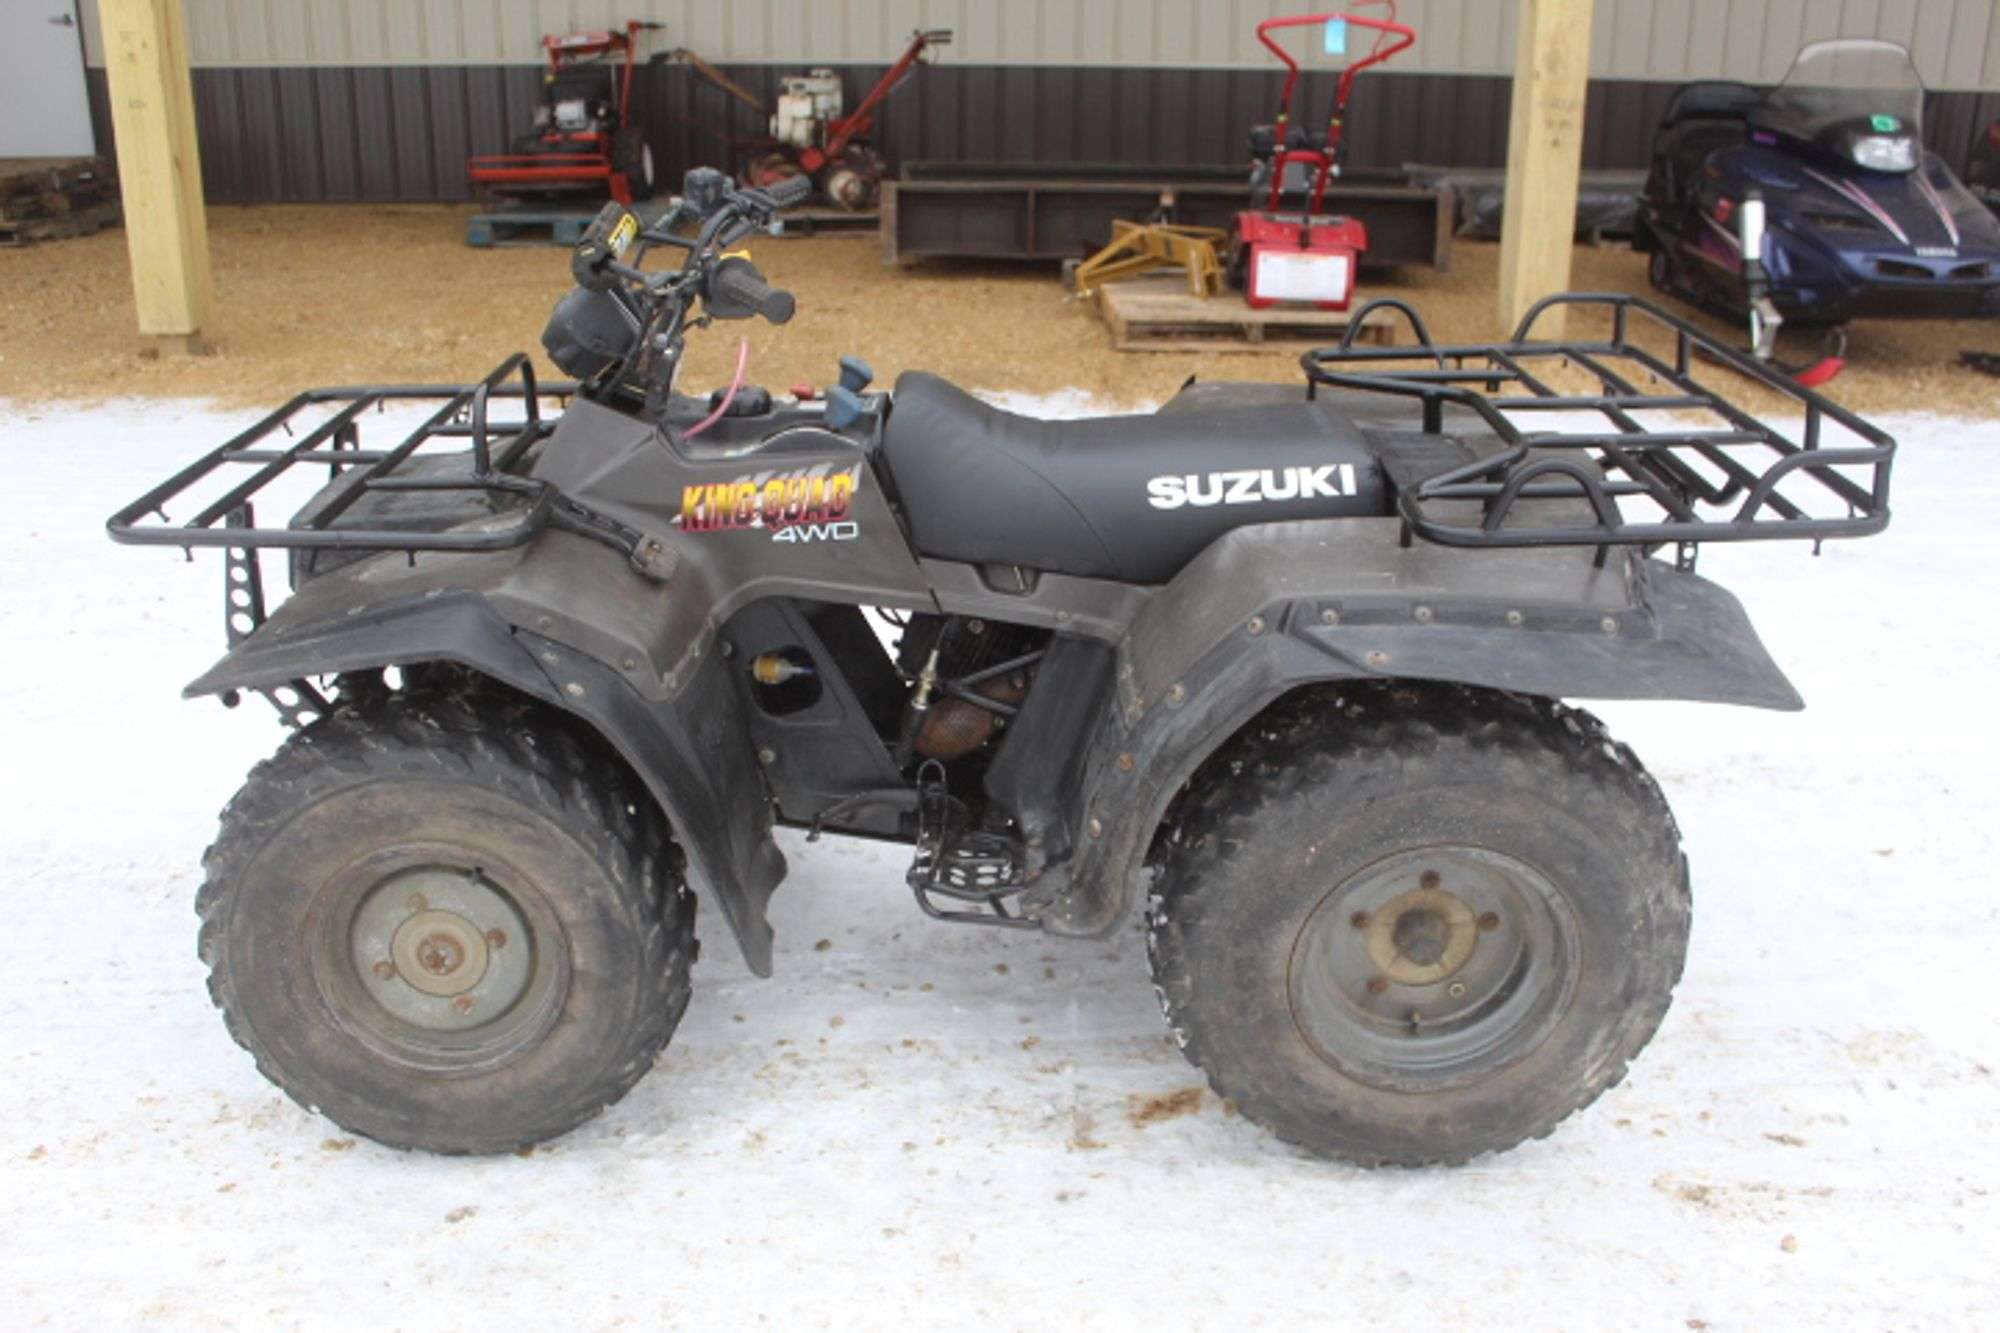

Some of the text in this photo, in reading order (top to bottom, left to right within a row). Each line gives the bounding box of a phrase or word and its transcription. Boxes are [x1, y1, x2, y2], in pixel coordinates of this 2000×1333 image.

[681, 472, 853, 532] KING QUAD
[1147, 463, 1357, 509] SUZUKI
[772, 522, 858, 542] 4WD
